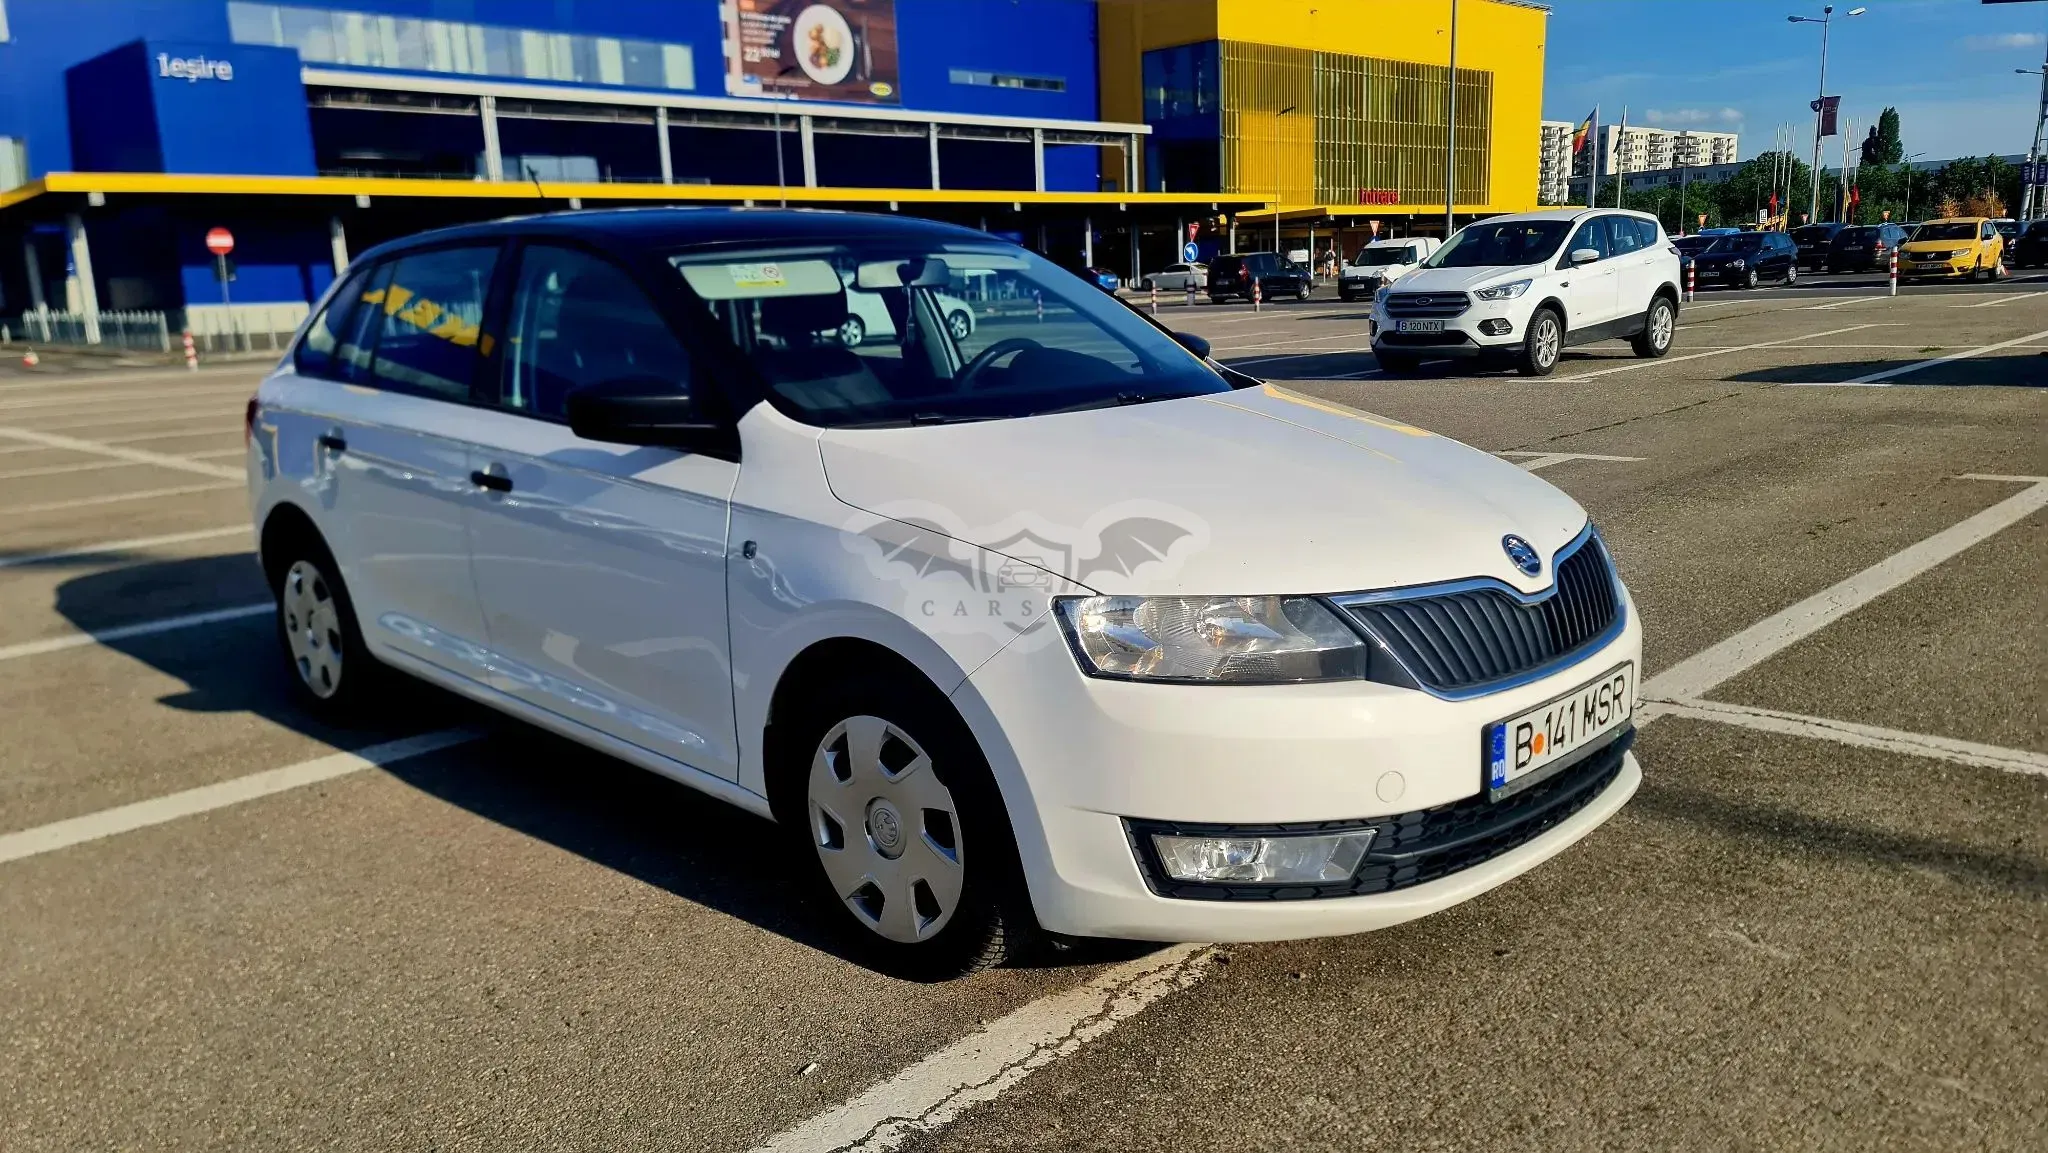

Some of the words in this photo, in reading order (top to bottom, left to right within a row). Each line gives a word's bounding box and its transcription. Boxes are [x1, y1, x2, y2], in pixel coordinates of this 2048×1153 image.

[1515, 721, 1534, 771] B
[1583, 674, 1625, 737] MSR
[1492, 758, 1506, 782] RO
